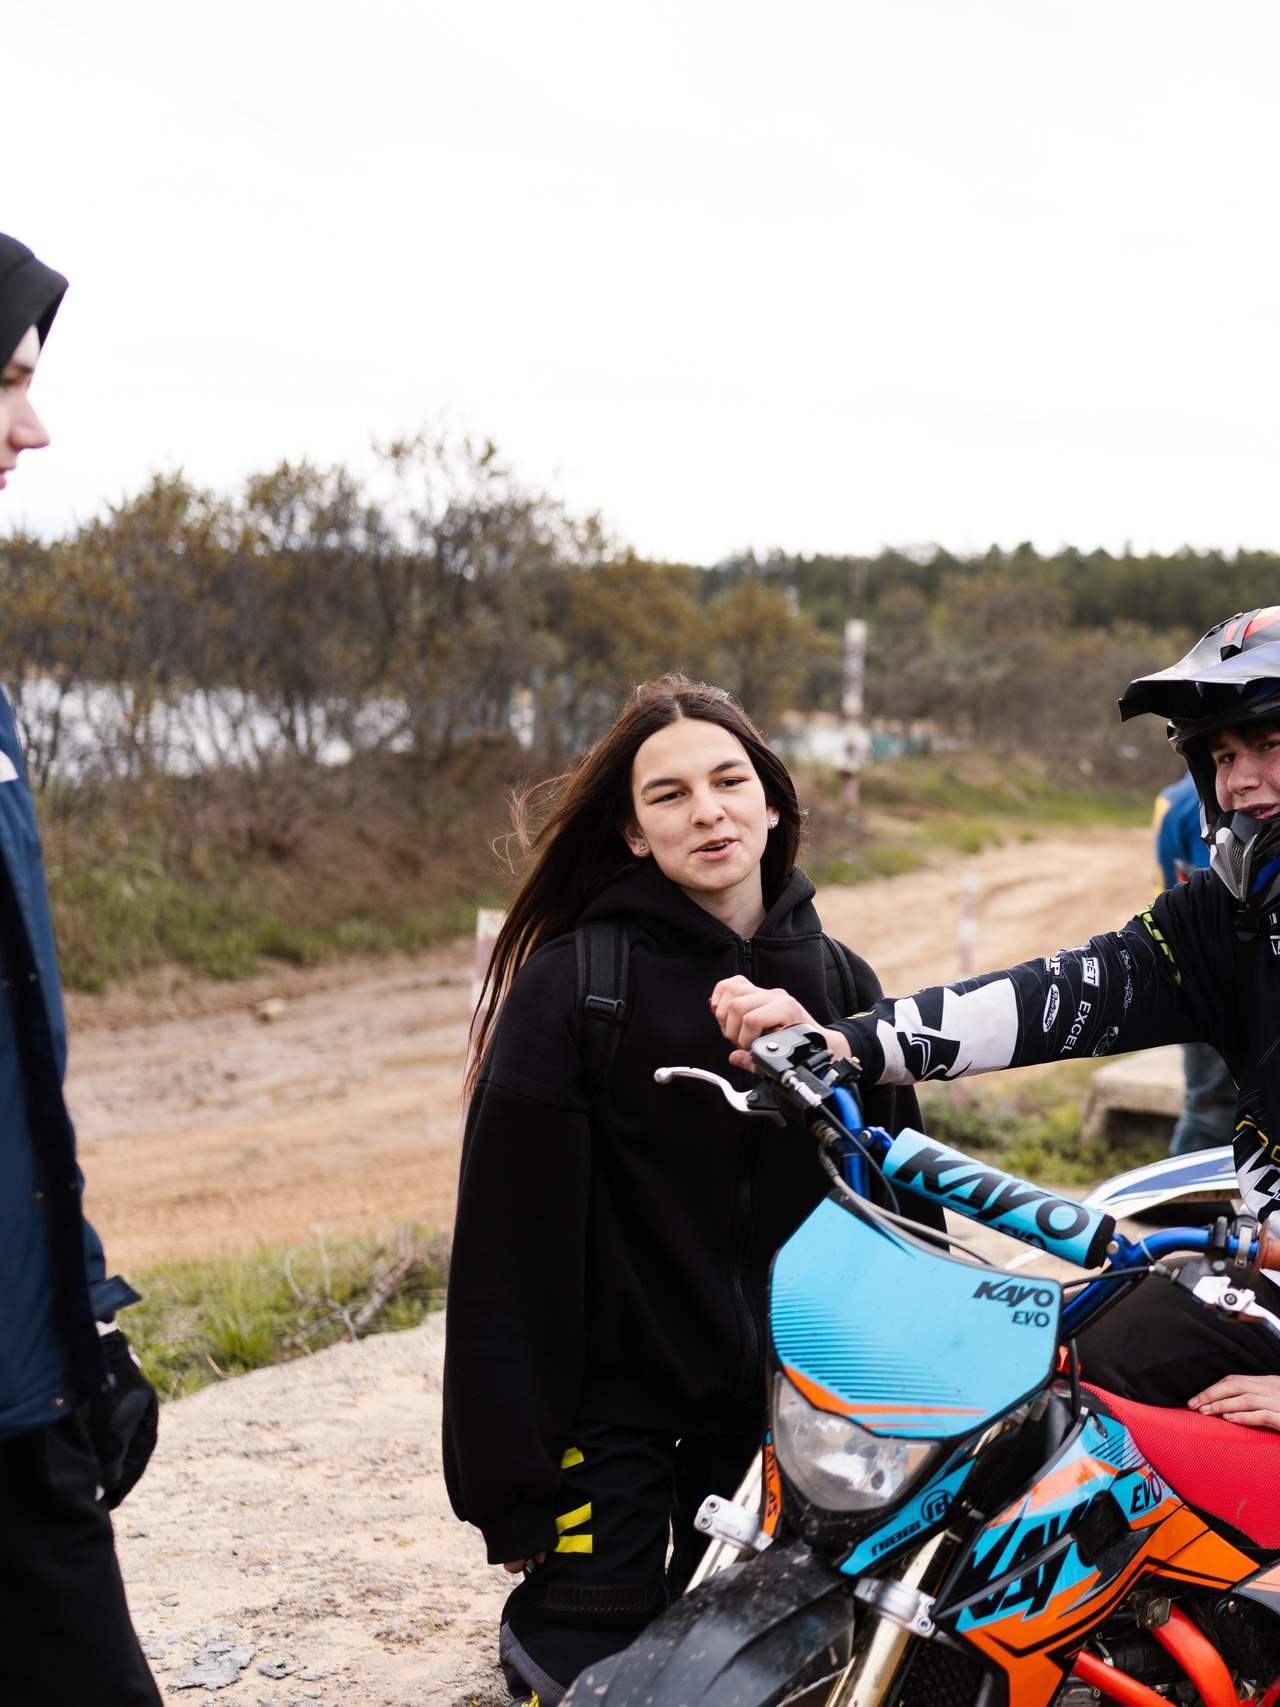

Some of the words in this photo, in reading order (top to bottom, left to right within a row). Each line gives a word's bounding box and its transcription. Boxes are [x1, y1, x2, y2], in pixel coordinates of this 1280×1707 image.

[1060, 1000, 1092, 1054] EXCEL
[892, 1146, 1090, 1239] KAYO
[973, 1276, 1055, 1308] KAYO
[1012, 1310, 1051, 1328] EVO
[1129, 1471, 1163, 1516] EVO
